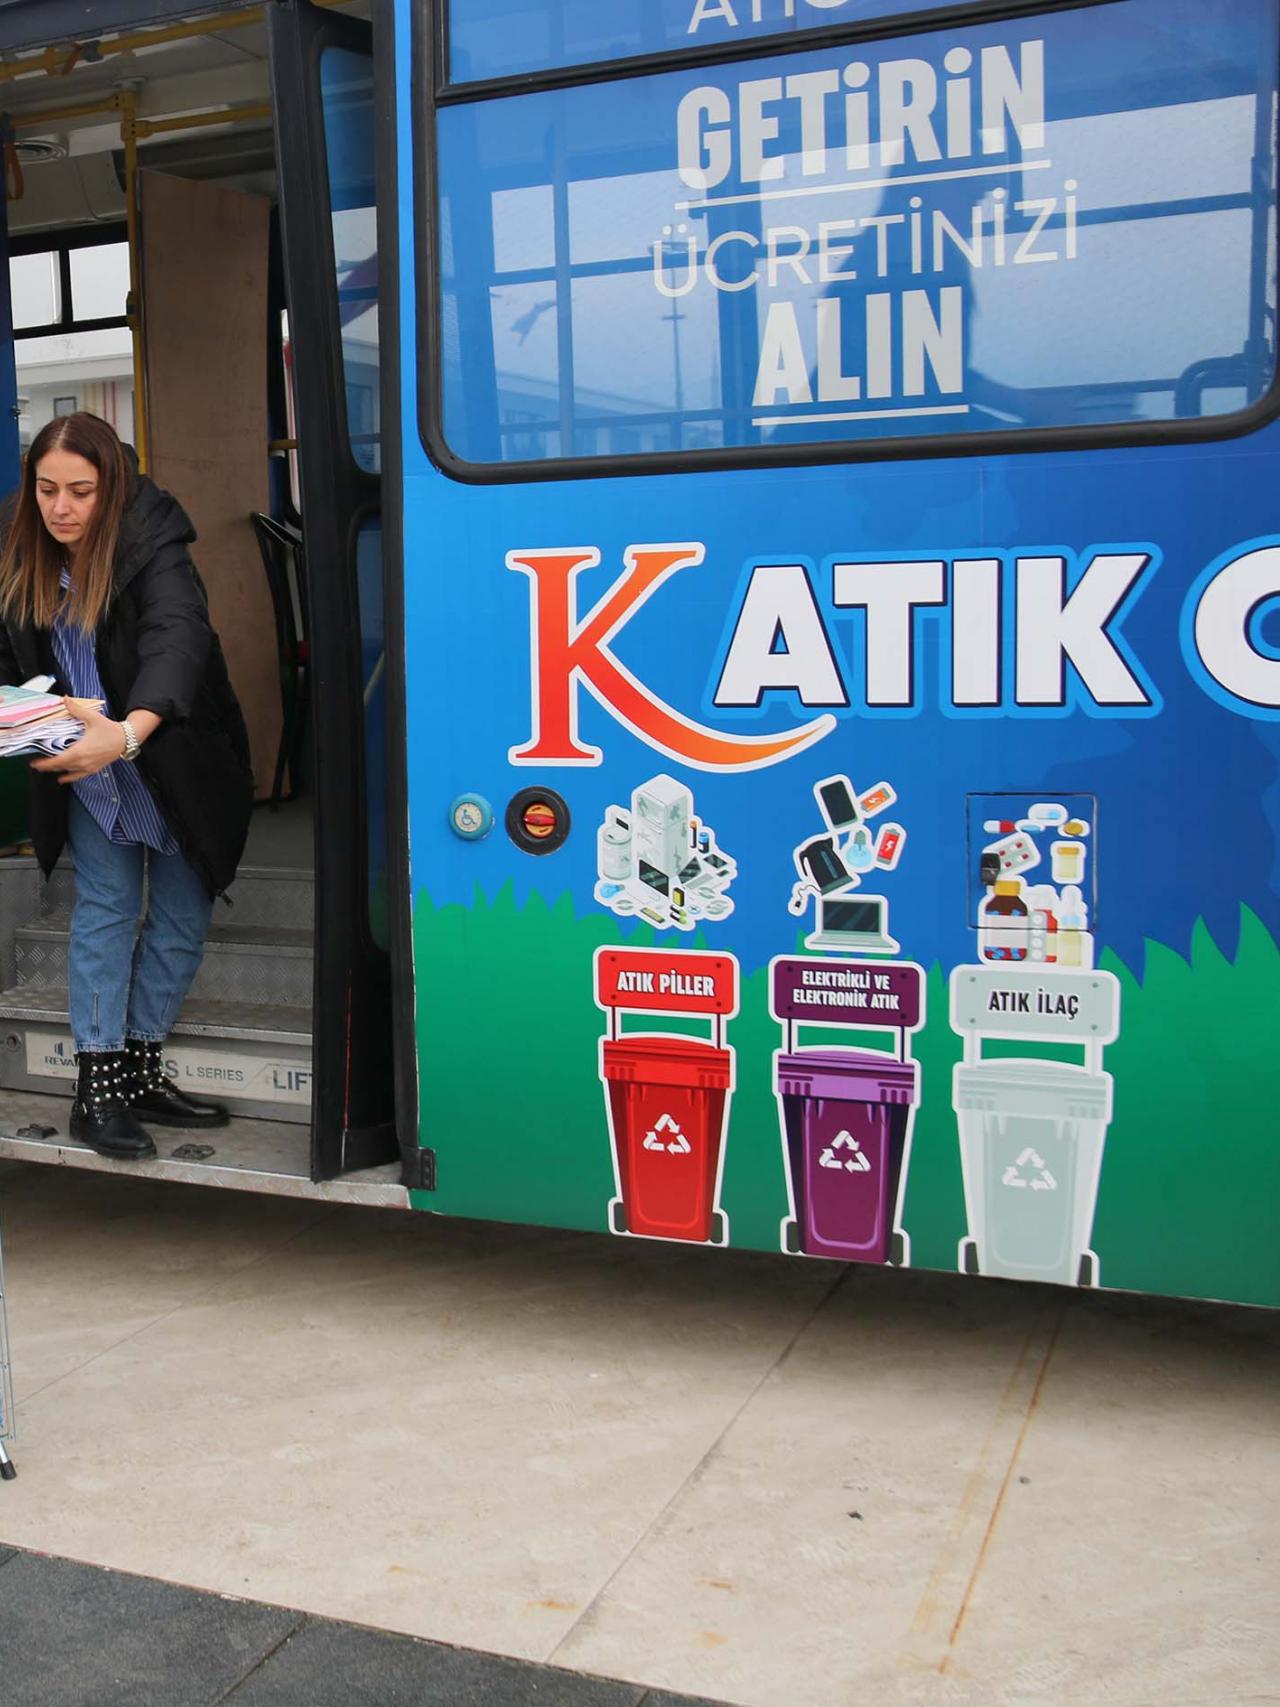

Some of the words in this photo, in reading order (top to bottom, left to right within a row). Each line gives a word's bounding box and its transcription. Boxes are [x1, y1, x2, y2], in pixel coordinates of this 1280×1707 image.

[653, 179, 1077, 297] ÜCRETİNİZİ
[752, 286, 963, 407] ALIN
[505, 541, 1158, 773] KATIK
[617, 970, 654, 993] ATIK
[659, 969, 716, 997] PİLLER
[802, 969, 870, 990] ELEKTRİKLİ
[874, 975, 891, 991] VE
[793, 988, 868, 1008] ELEKTRONİK
[870, 994, 899, 1010] ATIK
[988, 990, 1030, 1013] ATIK
[1037, 987, 1079, 1020] İLAÇ
[185, 1065, 193, 1077] L
[196, 1067, 244, 1081] SERIES
